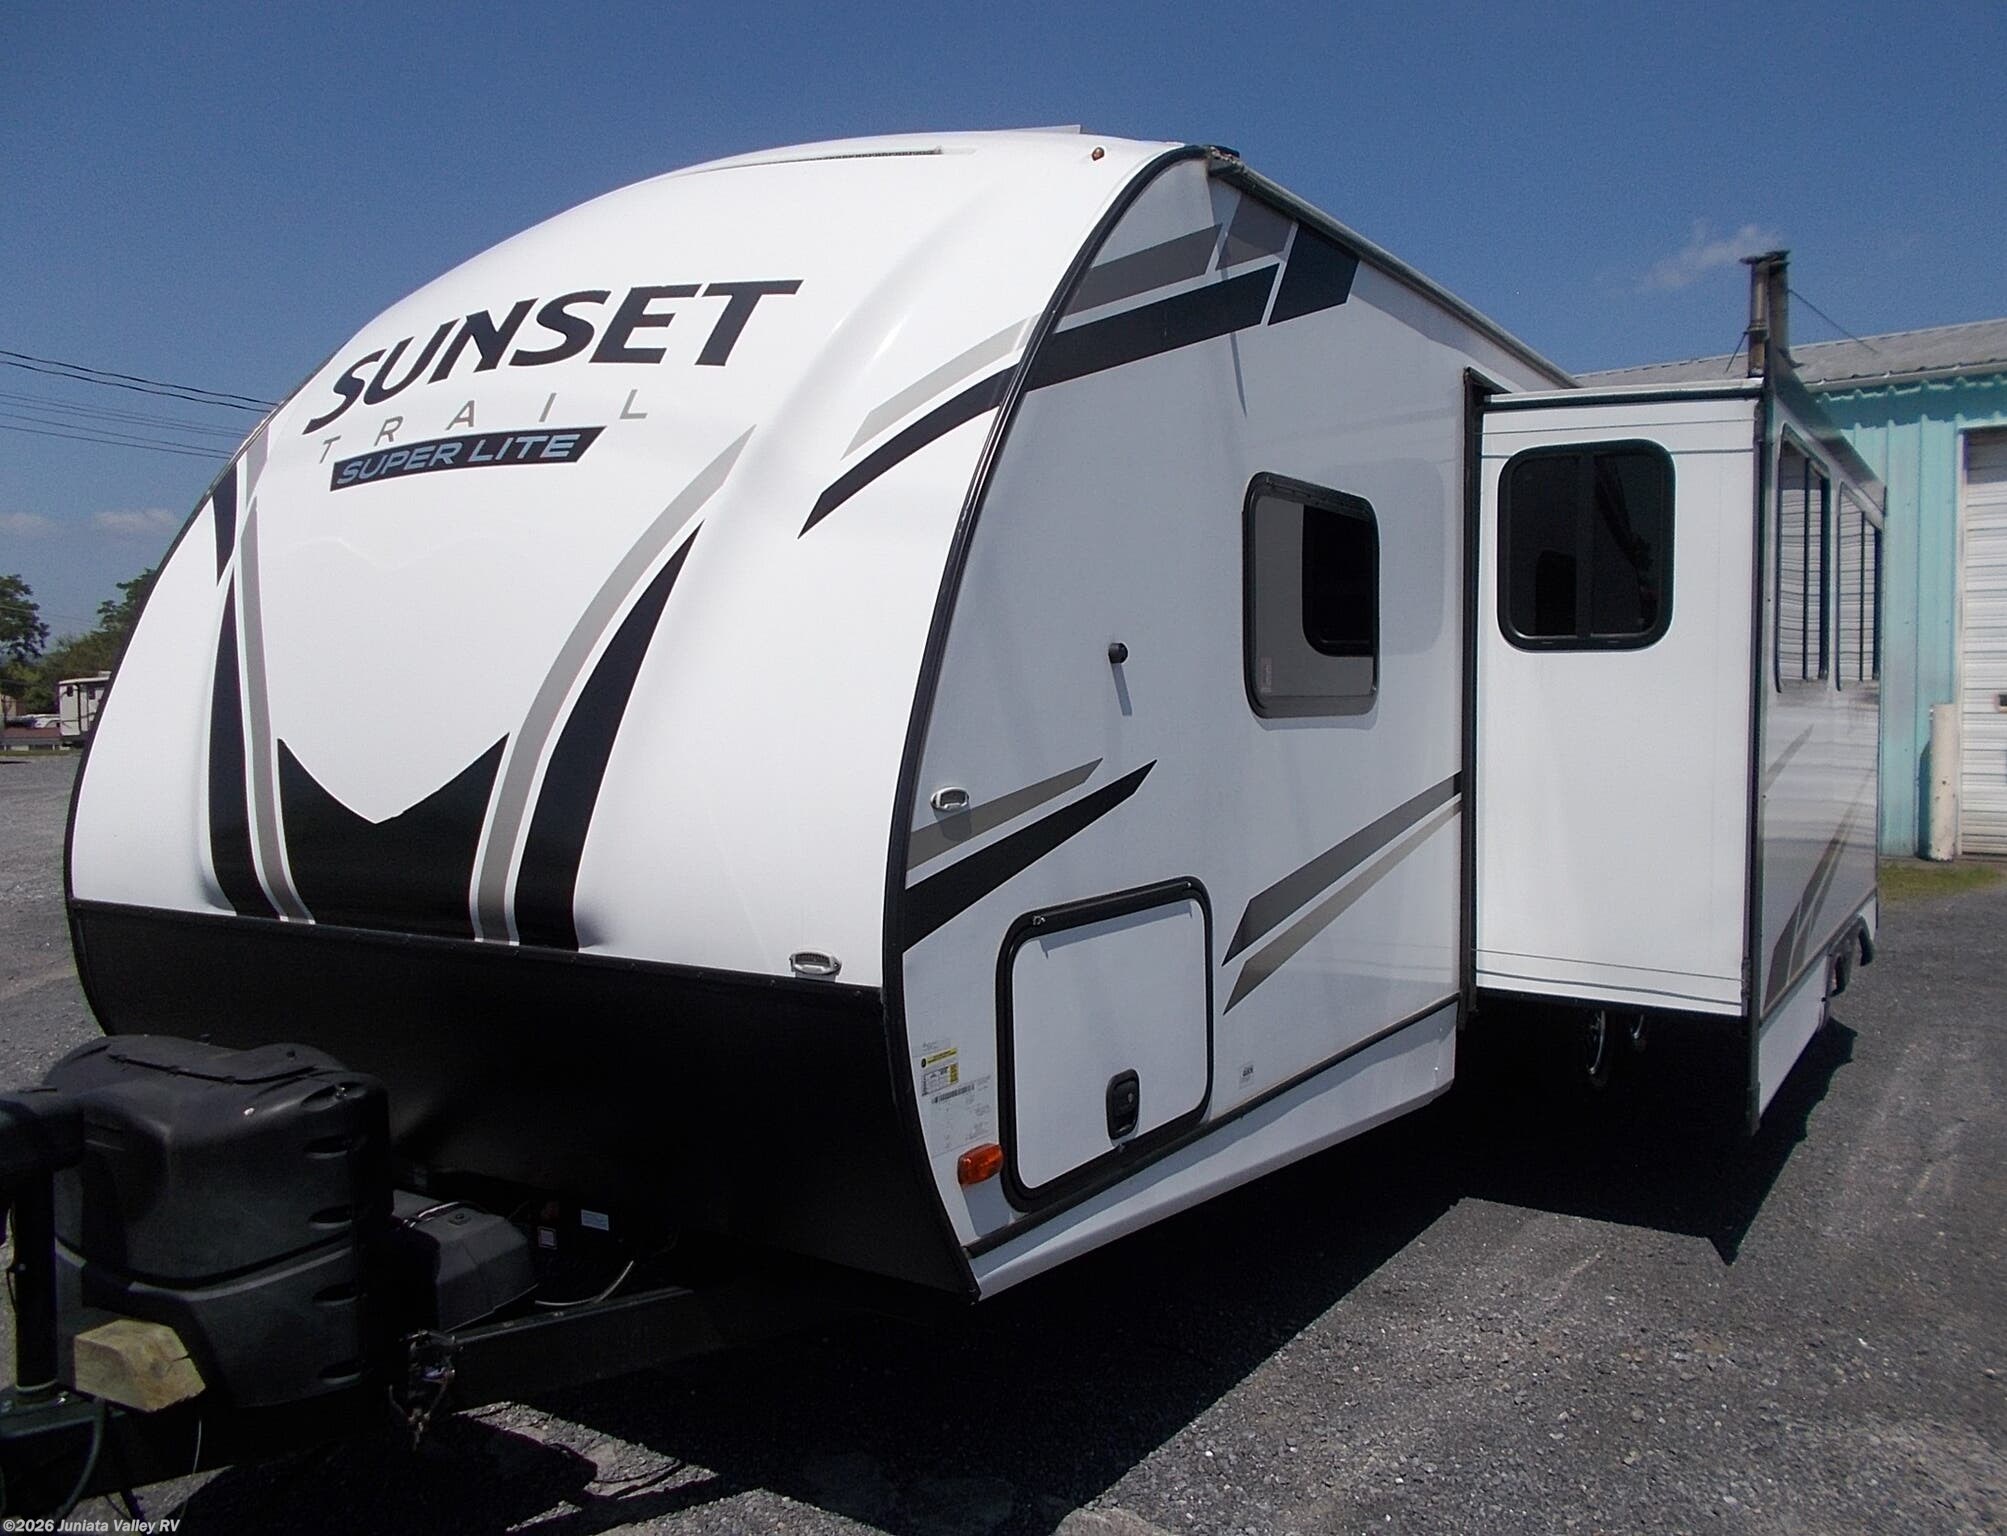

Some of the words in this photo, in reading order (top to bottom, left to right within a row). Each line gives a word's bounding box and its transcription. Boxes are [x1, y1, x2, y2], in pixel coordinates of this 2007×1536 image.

[302, 279, 804, 435] SUNSET
[319, 389, 648, 464] TRAIL
[336, 441, 461, 485] SUPER
[467, 434, 583, 462] LITE
